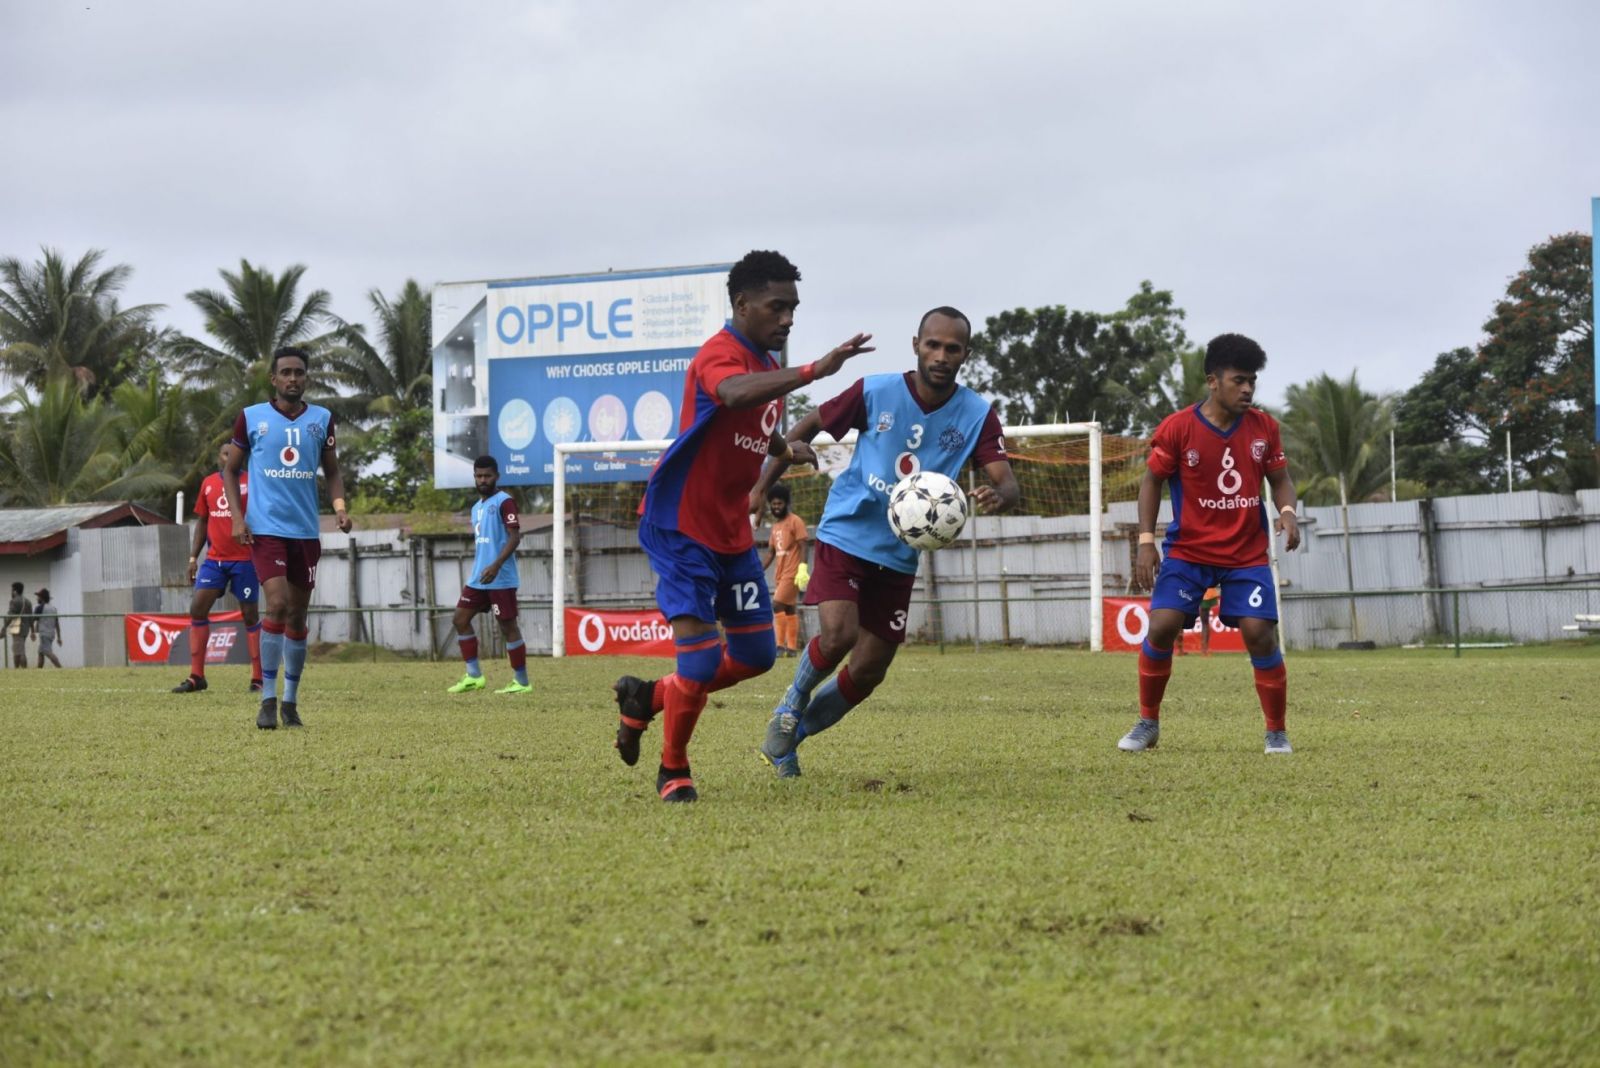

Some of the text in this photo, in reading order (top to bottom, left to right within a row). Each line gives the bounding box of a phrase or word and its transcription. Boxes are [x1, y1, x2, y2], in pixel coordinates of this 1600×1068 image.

[496, 298, 633, 345] OPPLE
[546, 365, 571, 379] WHY
[572, 362, 615, 377] CHOOSE
[616, 360, 650, 375] OPPLE
[285, 428, 300, 446] 11
[906, 424, 924, 449] 3
[593, 461, 610, 471] Color
[1221, 447, 1235, 469] 6
[264, 467, 314, 479] vodafone
[1198, 495, 1260, 510] vodafone
[243, 587, 252, 599] 9
[731, 581, 760, 611] 12
[1248, 585, 1262, 608] 6
[889, 609, 907, 631] 3
[206, 632, 237, 648] FBC
